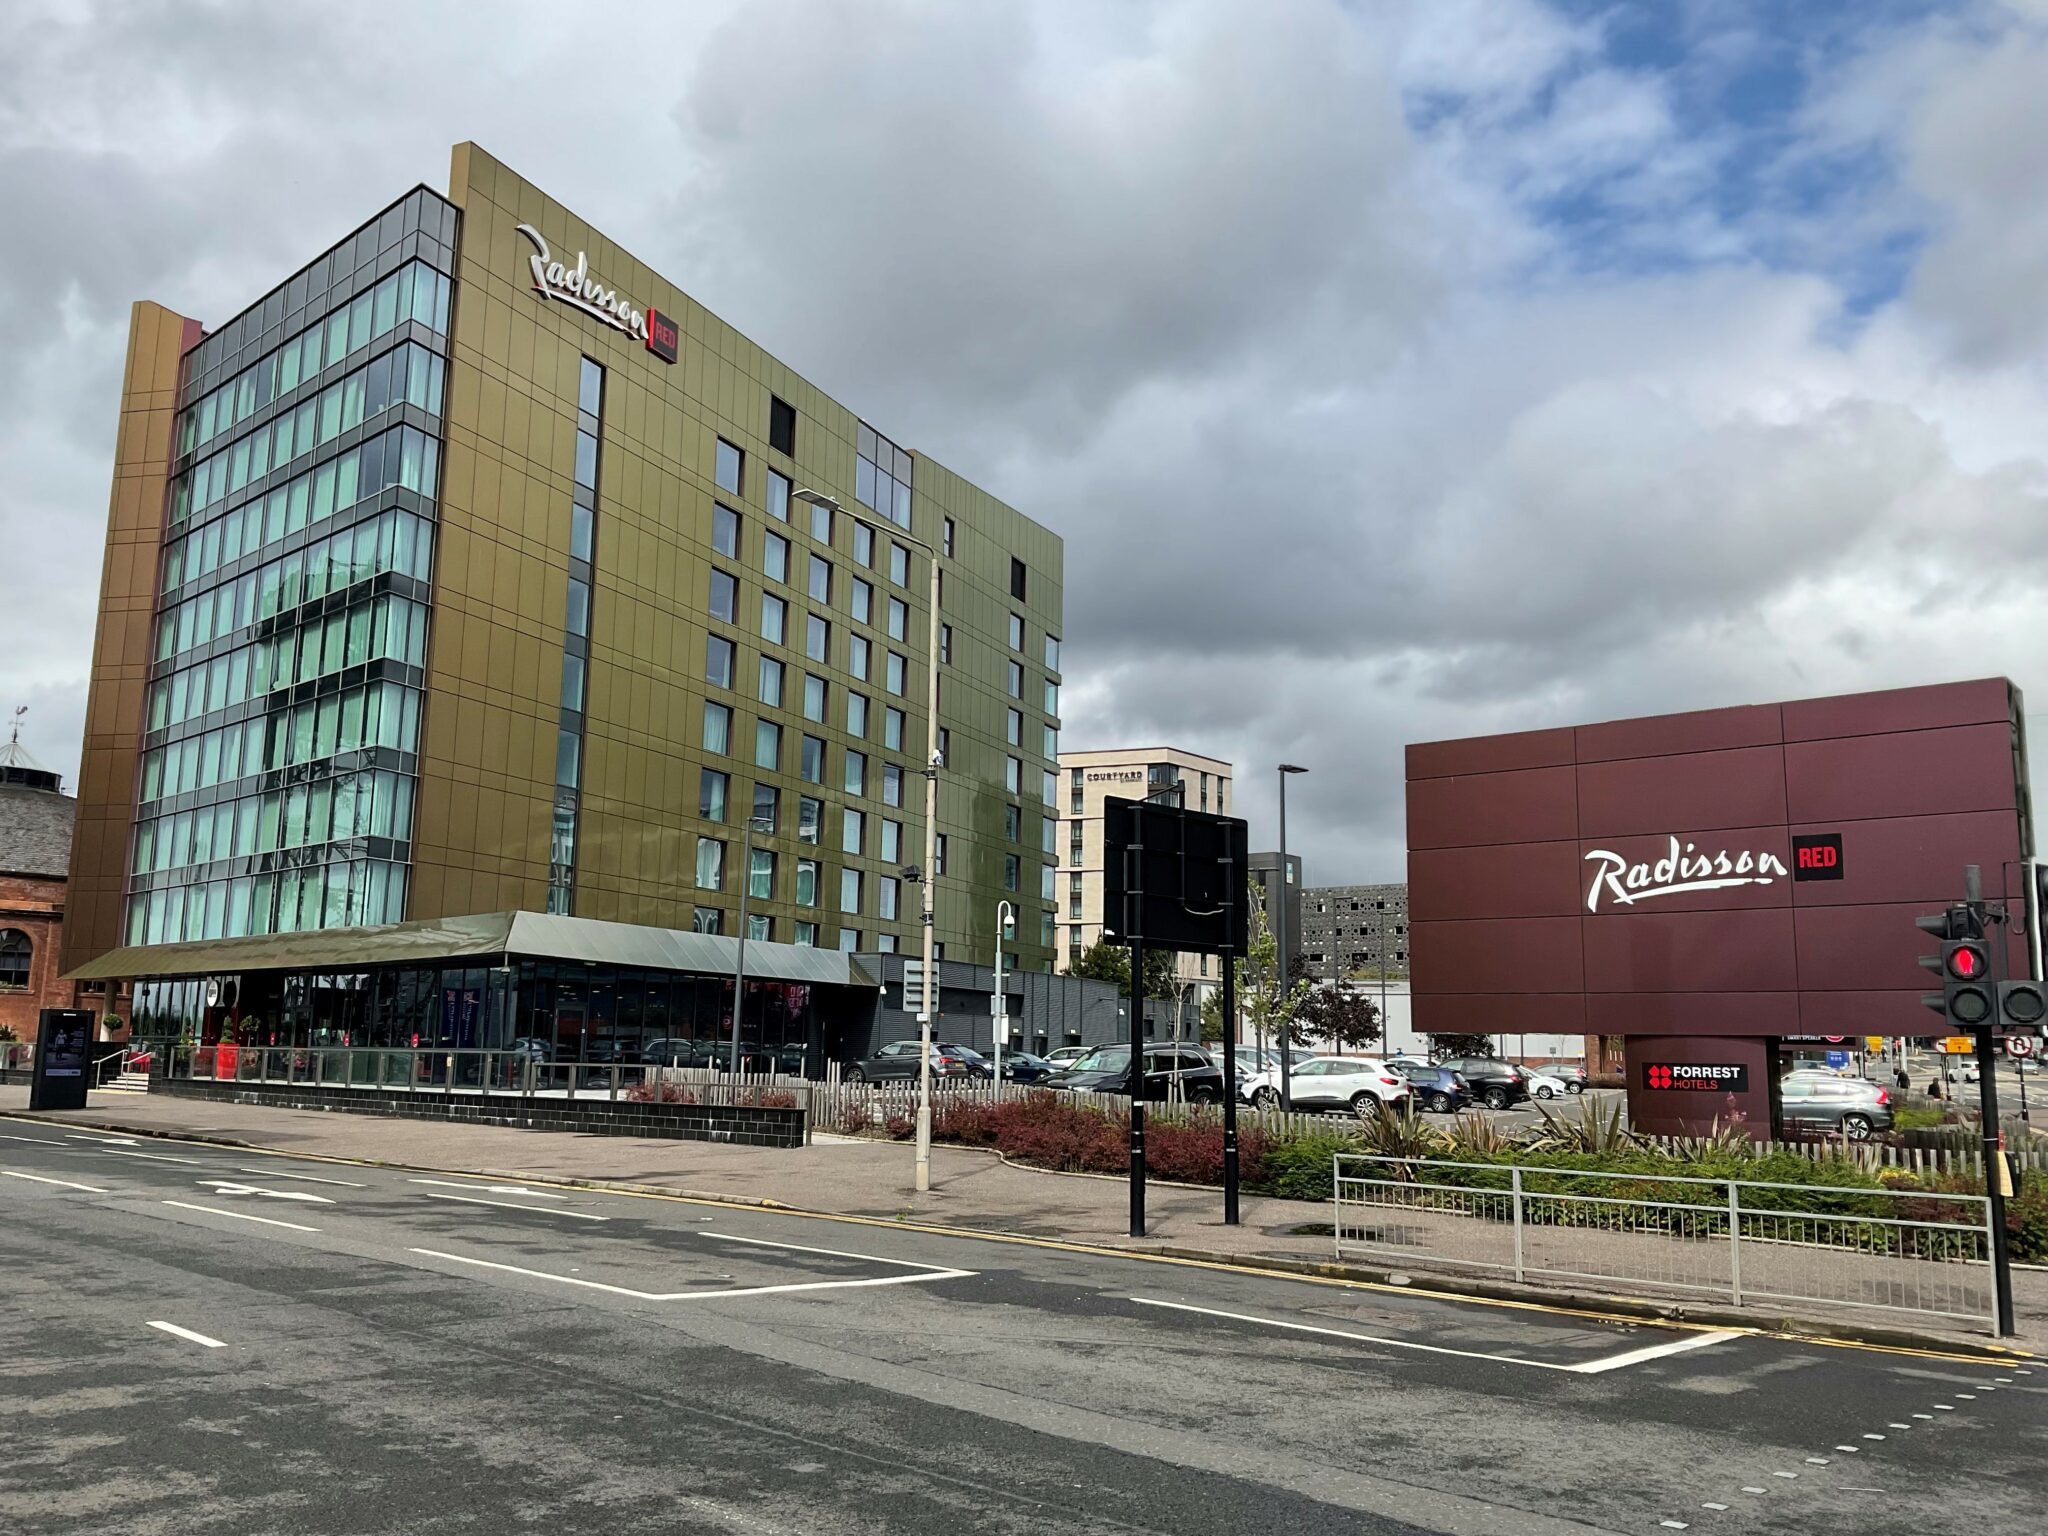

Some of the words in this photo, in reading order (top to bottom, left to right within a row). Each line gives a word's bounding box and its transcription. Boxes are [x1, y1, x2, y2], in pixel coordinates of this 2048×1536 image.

[515, 223, 649, 340] Radisson
[655, 321, 676, 349] RED
[1087, 771, 1143, 782] COURTYARD
[1585, 836, 1788, 913] Radisson
[1799, 846, 1837, 868] RED
[1673, 1066, 1740, 1079] FORREST
[1674, 1080, 1718, 1090] HOTELS
